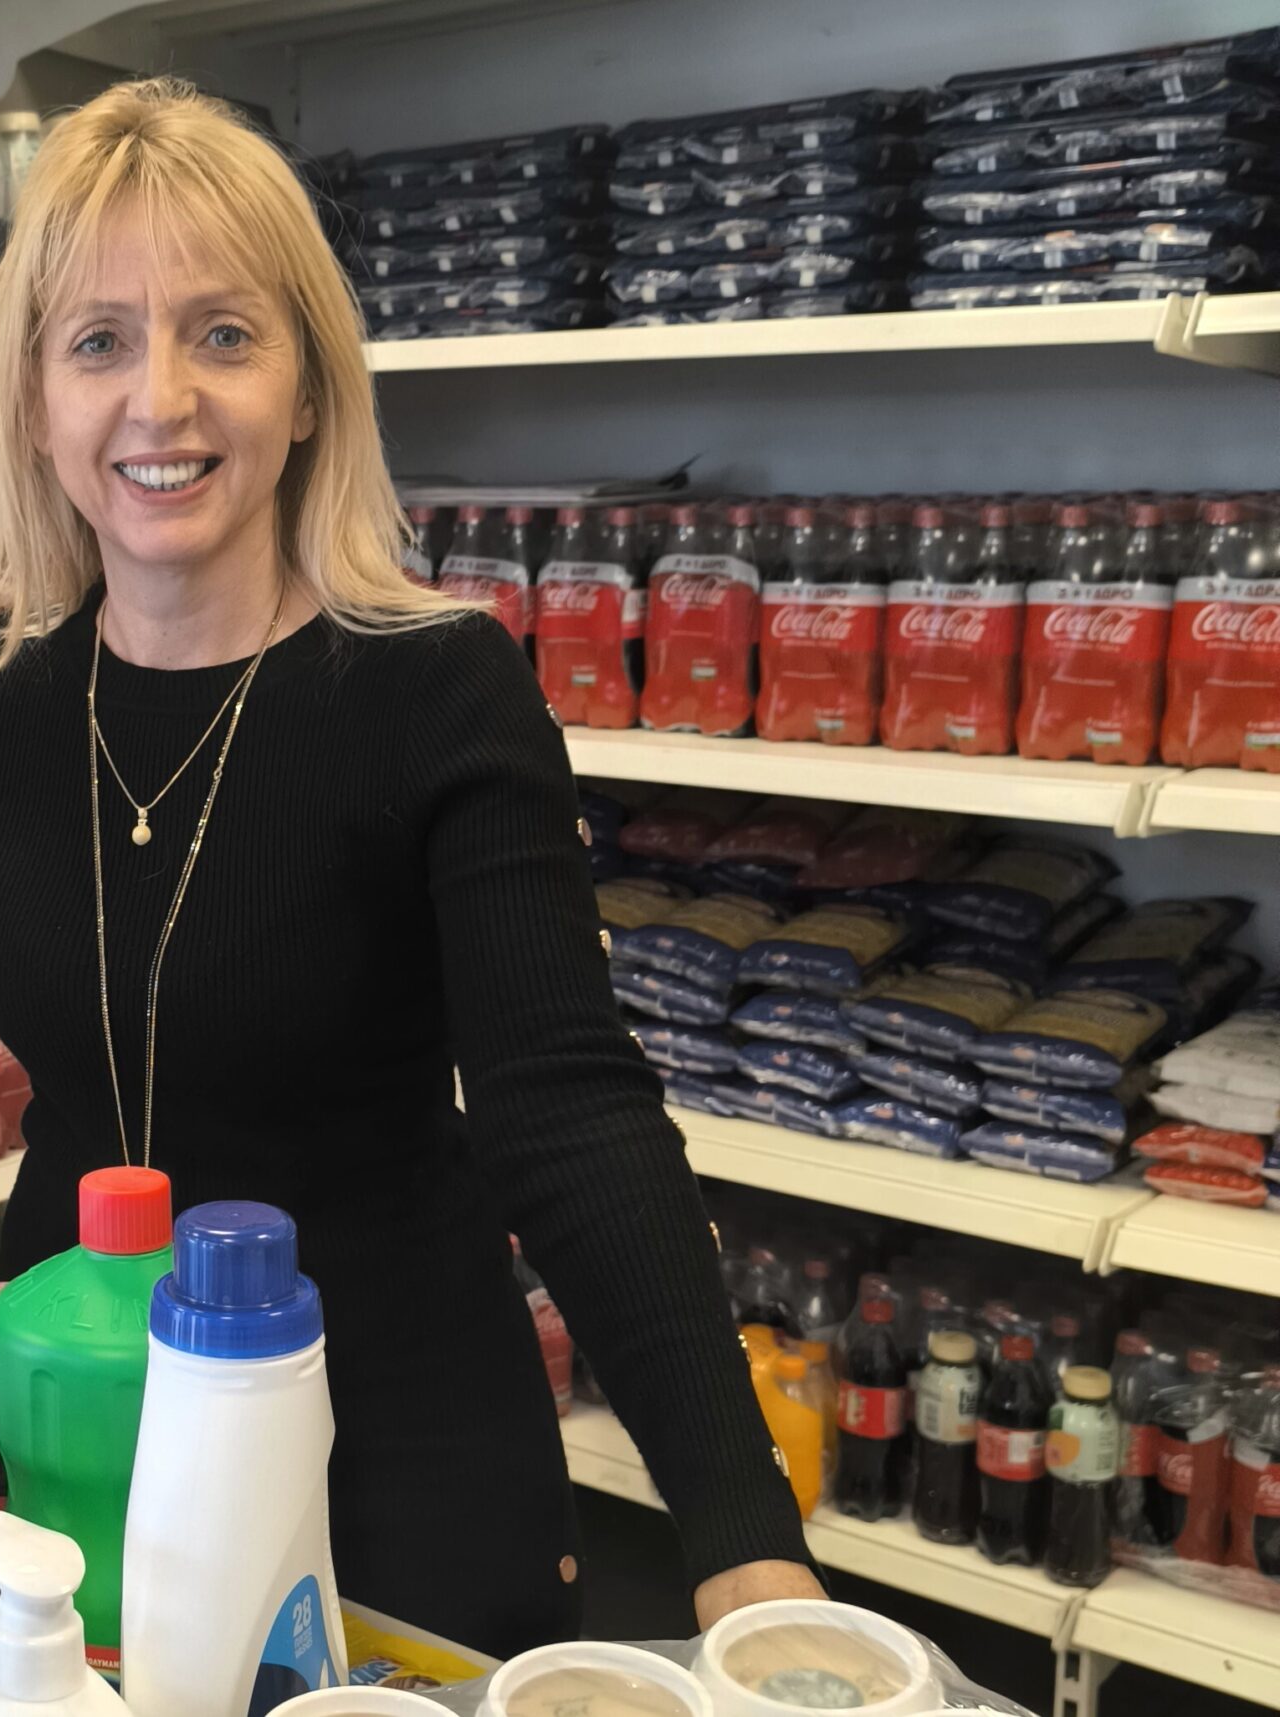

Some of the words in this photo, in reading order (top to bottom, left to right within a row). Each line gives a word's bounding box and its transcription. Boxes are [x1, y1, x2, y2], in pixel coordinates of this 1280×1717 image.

[771, 605, 860, 640] Coca-Cola
[899, 605, 989, 643] Coca-Cola
[1043, 606, 1144, 644] Coca-Cola
[292, 1593, 312, 1638] 28
